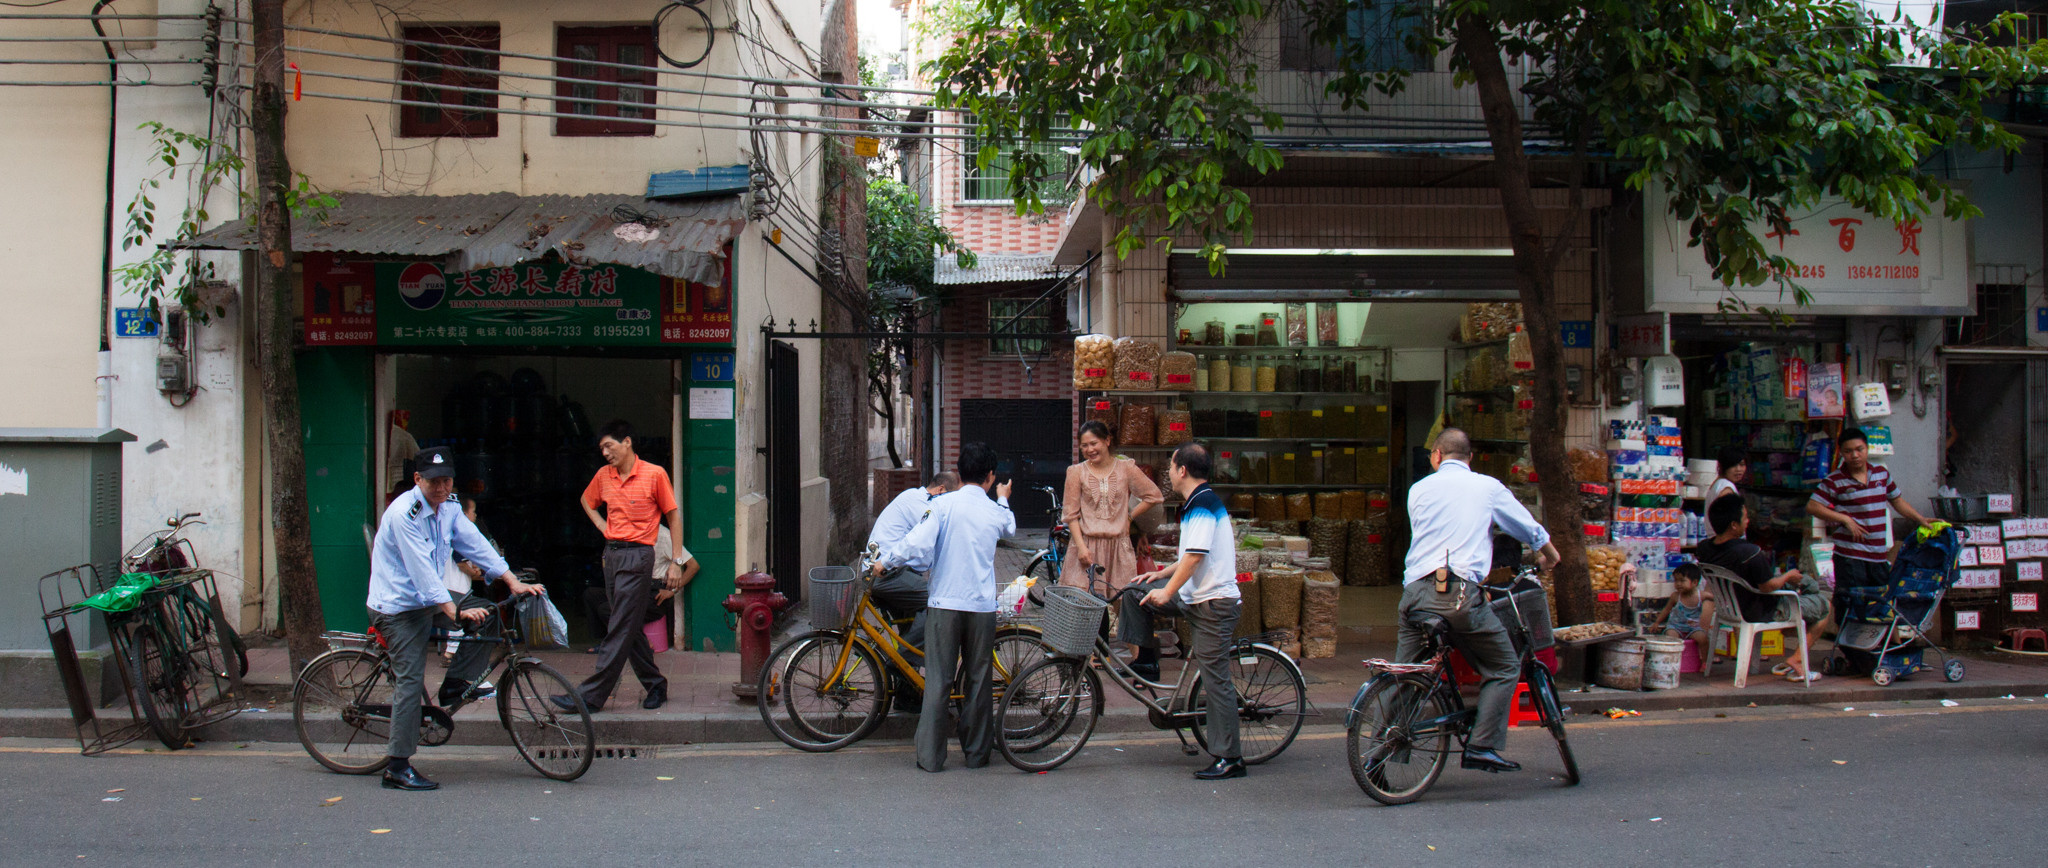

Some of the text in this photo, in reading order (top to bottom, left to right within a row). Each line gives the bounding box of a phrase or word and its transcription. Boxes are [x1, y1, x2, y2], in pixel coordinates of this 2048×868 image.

[1847, 265, 1920, 279] 13642712109
[450, 299, 623, 308] TIAN YUAN CHANG SHOU VILLAGE
[616, 308, 651, 321] 健康水
[334, 331, 373, 340] 82492097
[393, 325, 468, 338] 第二十六专卖店
[504, 325, 582, 337] 400-884-7333
[593, 325, 651, 338] 81955291
[689, 328, 730, 338] 82492097
[1567, 331, 1577, 346] 8
[705, 364, 721, 379] 10
